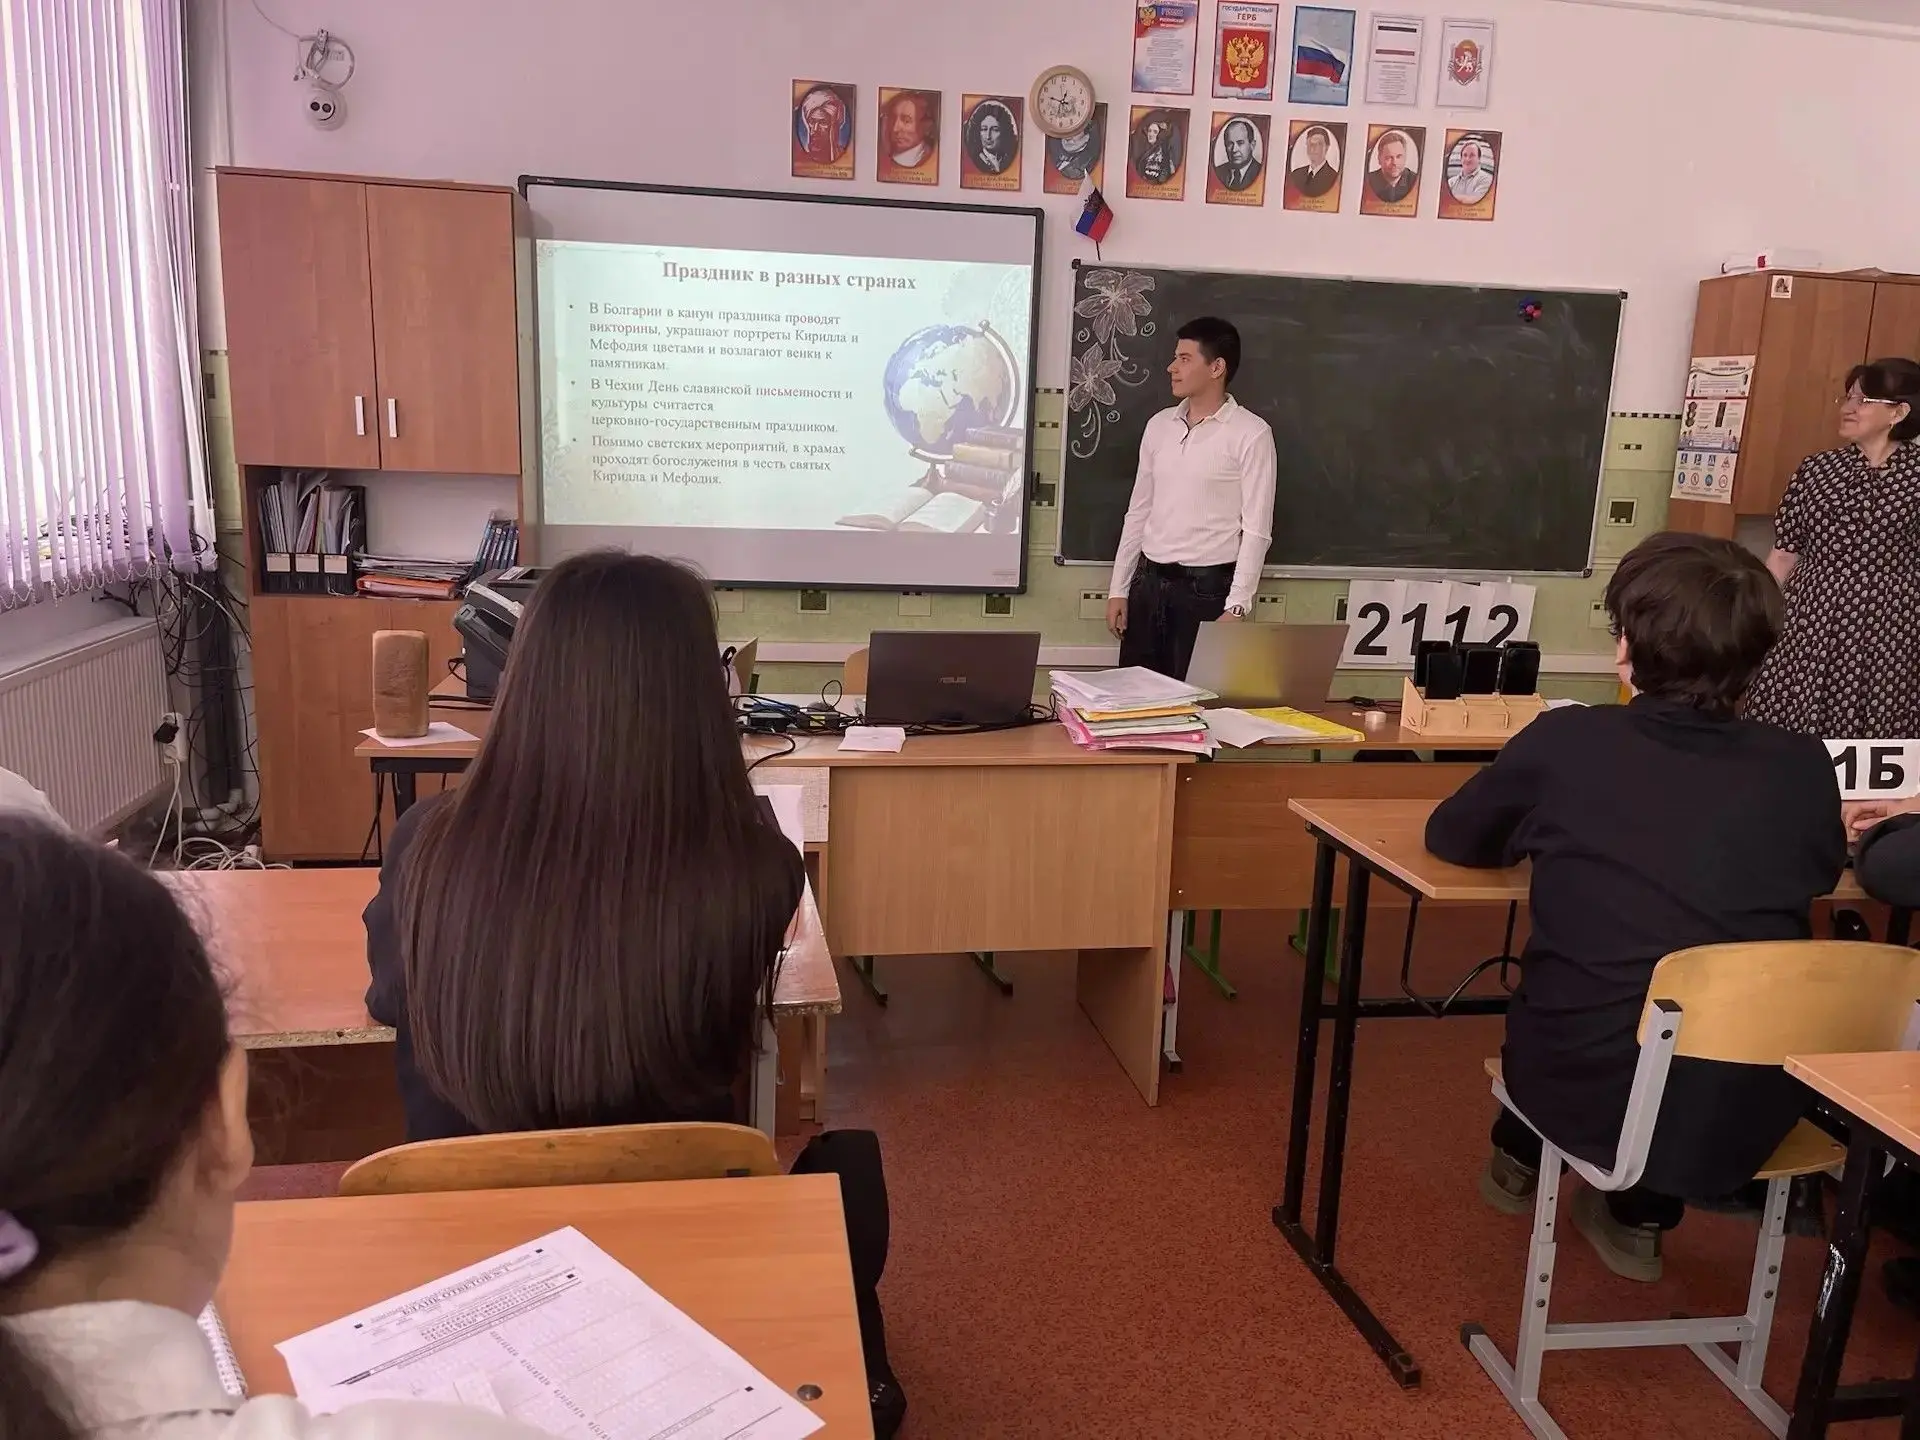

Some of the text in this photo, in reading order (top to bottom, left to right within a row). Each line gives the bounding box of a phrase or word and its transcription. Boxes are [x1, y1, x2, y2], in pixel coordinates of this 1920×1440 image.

[1237, 13, 1257, 21] ГЕРБ
[662, 261, 917, 292] Праздник в разных странах
[589, 302, 841, 326] В Болгарии в канун праздника проводят
[589, 322, 859, 344] викторины, украшают портреты Кирилла и
[589, 338, 832, 359] Мефодия цветами и возлагают венки к
[591, 378, 853, 399] В Чехии День славянской письменности и
[591, 398, 714, 412] культуры считается
[591, 415, 761, 431] церковно-государственным
[592, 435, 644, 448] Помимо
[647, 440, 702, 450] светских
[792, 445, 799, 453] в
[803, 444, 846, 456] храмах
[592, 454, 831, 471] проходят богослужения в честь святых
[593, 469, 722, 486] Кирилла и Мефодия.
